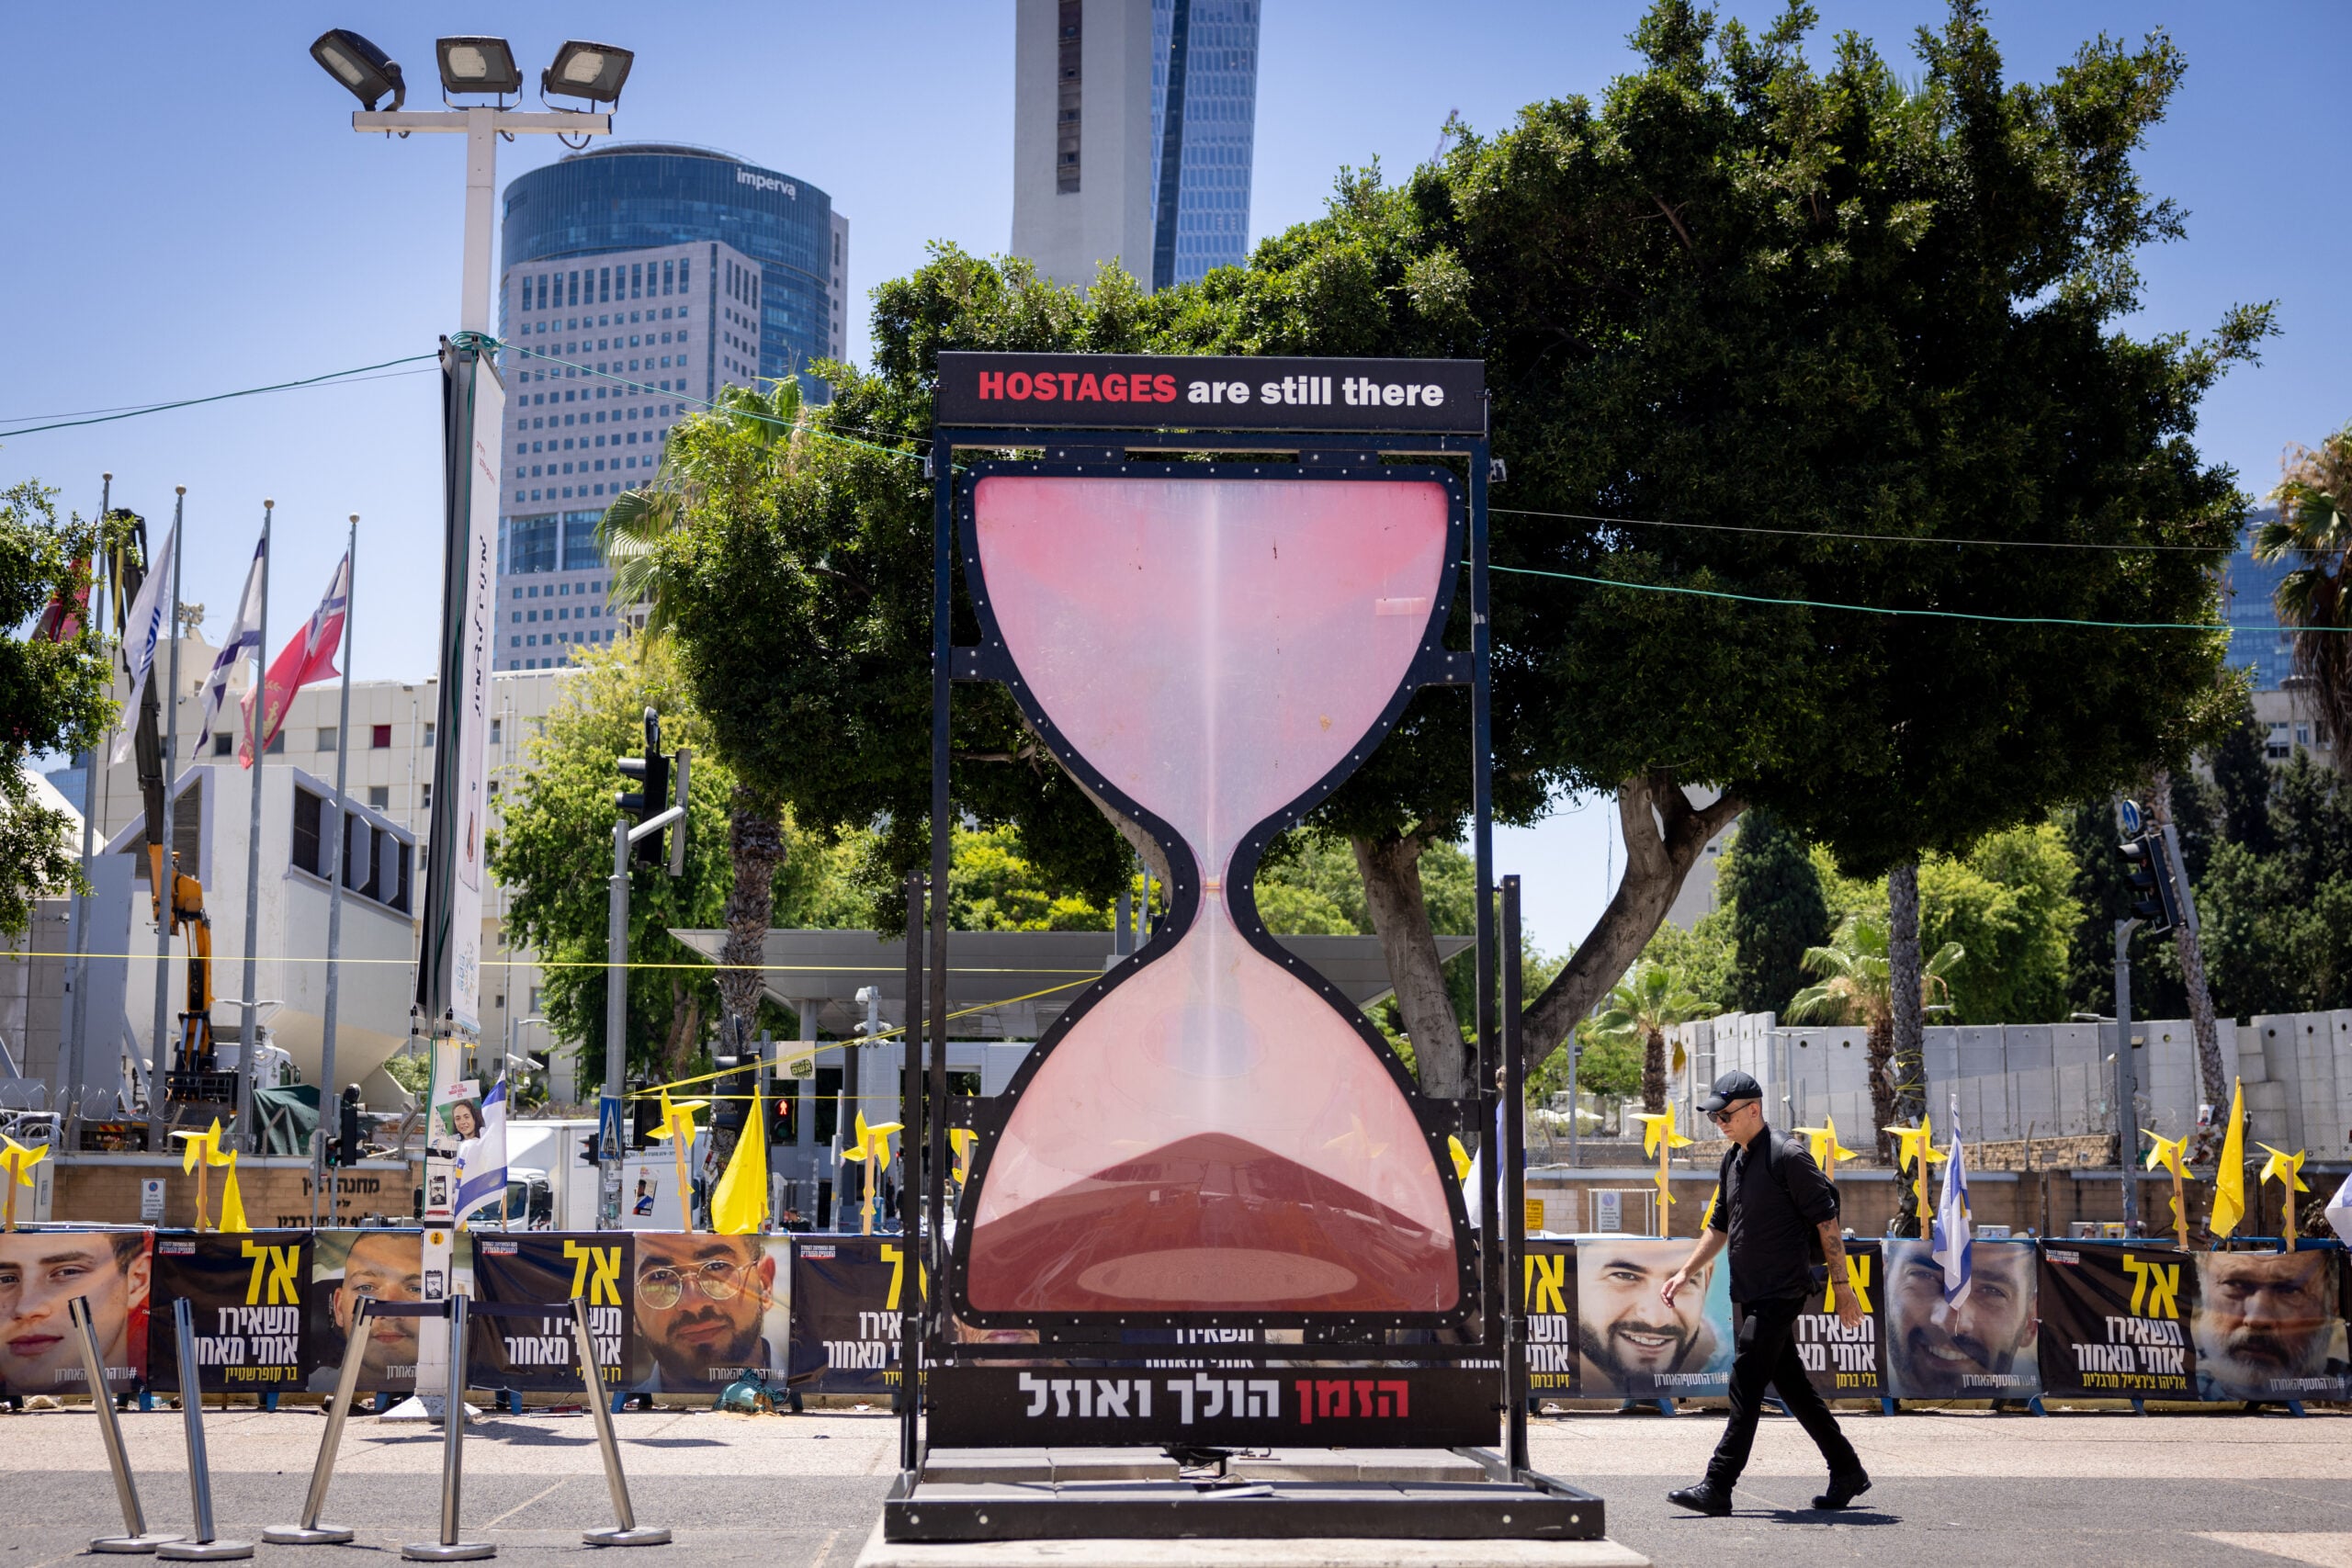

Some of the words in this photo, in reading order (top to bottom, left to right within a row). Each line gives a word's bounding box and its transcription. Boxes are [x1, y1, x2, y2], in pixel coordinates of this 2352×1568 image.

[737, 167, 796, 197] imperva
[978, 371, 1177, 402] HOSTAGES
[1187, 379, 1250, 404] are
[1260, 375, 1331, 405] still
[1341, 377, 1444, 407] there
[242, 1240, 300, 1305] אל
[563, 1240, 623, 1306] אל
[2122, 1254, 2180, 1319] אל
[219, 1306, 300, 1335] תשאירו
[2105, 1315, 2185, 1347] תשאירו
[194, 1337, 245, 1365] מאחו
[251, 1337, 299, 1364] אותי
[504, 1337, 569, 1365] מאחור
[822, 1340, 887, 1369] מאחור
[1830, 1343, 1877, 1371] אותי
[2072, 1343, 2136, 1372] מאחור
[2138, 1345, 2185, 1374] אותי
[225, 1366, 282, 1383] קופרשטיין
[284, 1366, 298, 1381] בר
[610, 1367, 622, 1383] רן
[1530, 1374, 1555, 1390] ברמן
[1555, 1374, 1570, 1388] זיו
[1836, 1373, 1860, 1390] ברמן
[1861, 1372, 1878, 1388] גלי
[2082, 1372, 2120, 1388] מרגלית
[2157, 1375, 2188, 1390] אליהו
[1019, 1371, 1151, 1417] ואוזל
[1167, 1372, 1280, 1425] הולך
[1295, 1379, 1409, 1425] הזמן
